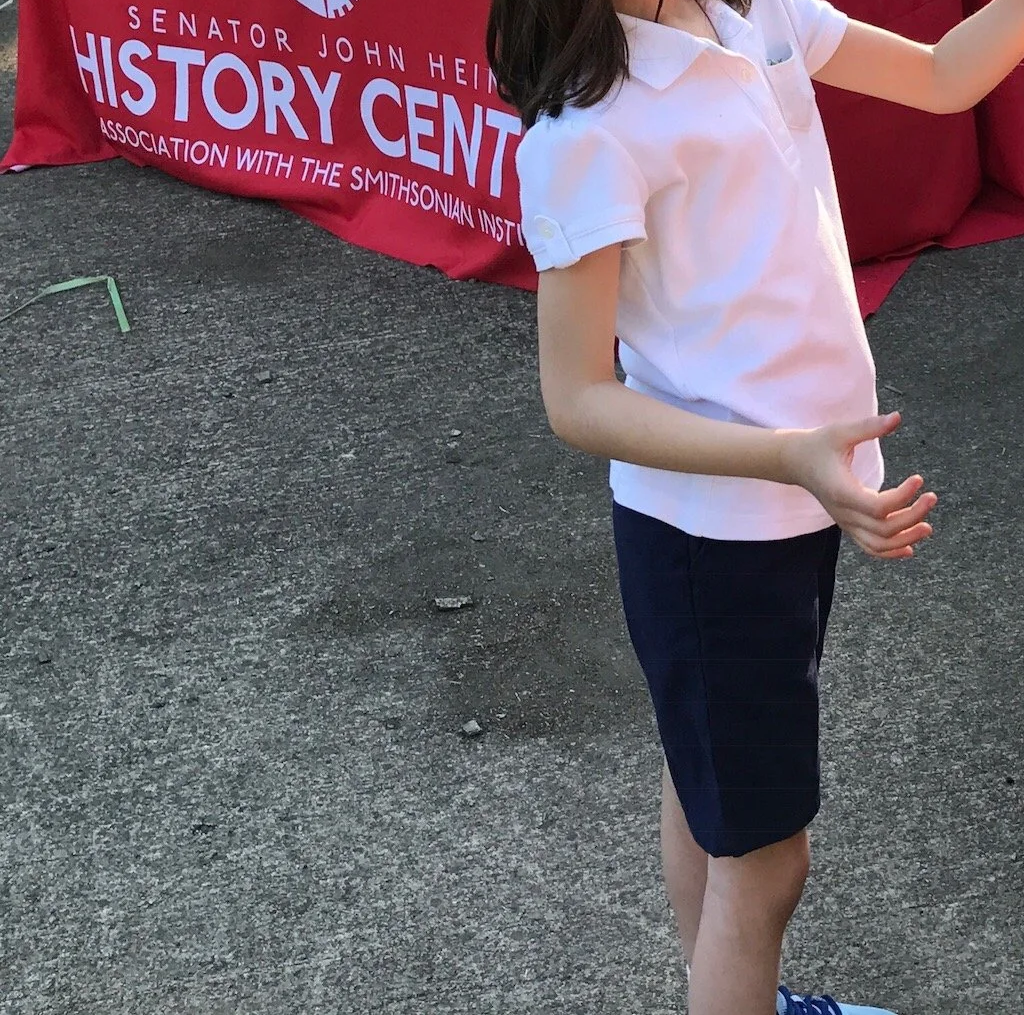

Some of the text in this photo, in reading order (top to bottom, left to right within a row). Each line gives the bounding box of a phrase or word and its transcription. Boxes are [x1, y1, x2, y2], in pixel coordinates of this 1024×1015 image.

[69, 24, 341, 146] HISTORY
[128, 5, 293, 53] SENATOR
[318, 33, 405, 73] JOHN
[100, 117, 230, 168] ASSOCIATION
[236, 146, 294, 179] WITH
[301, 157, 344, 188] THE
[350, 165, 475, 229] SMITHSONIAN
